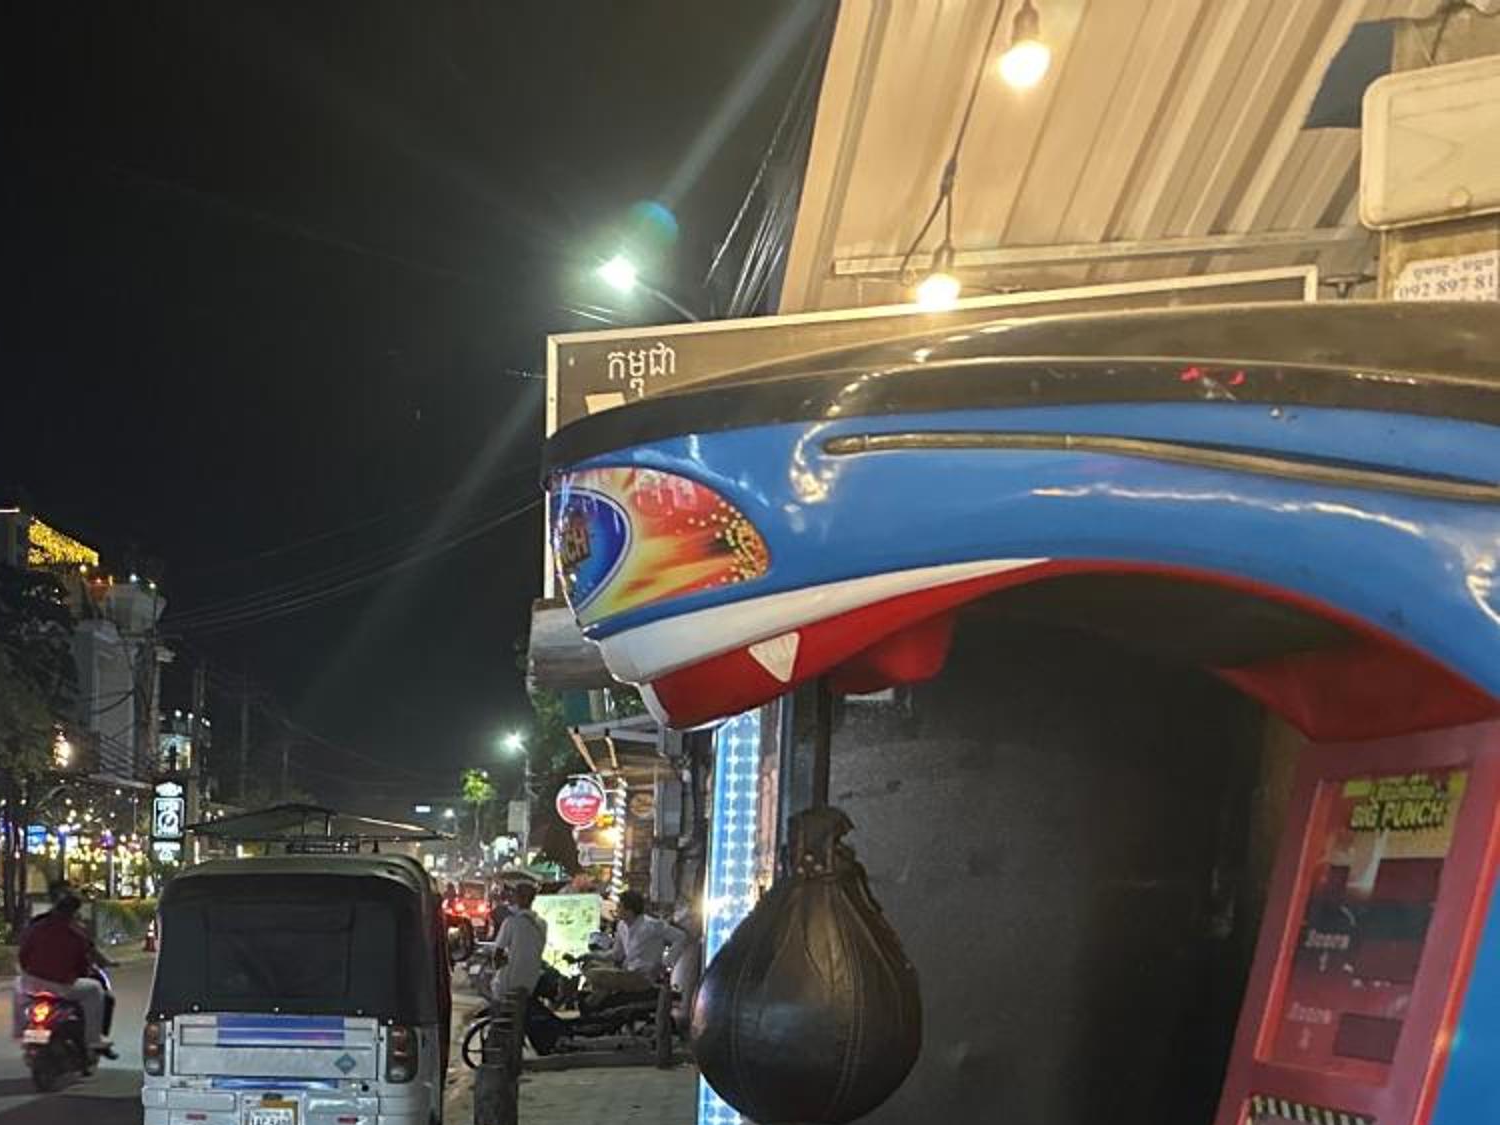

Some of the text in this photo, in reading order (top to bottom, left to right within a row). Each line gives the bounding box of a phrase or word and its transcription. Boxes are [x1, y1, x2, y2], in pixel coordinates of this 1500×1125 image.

[606, 342, 676, 398] កម្ពុជា
[1349, 799, 1446, 828] BIG PUNCH
